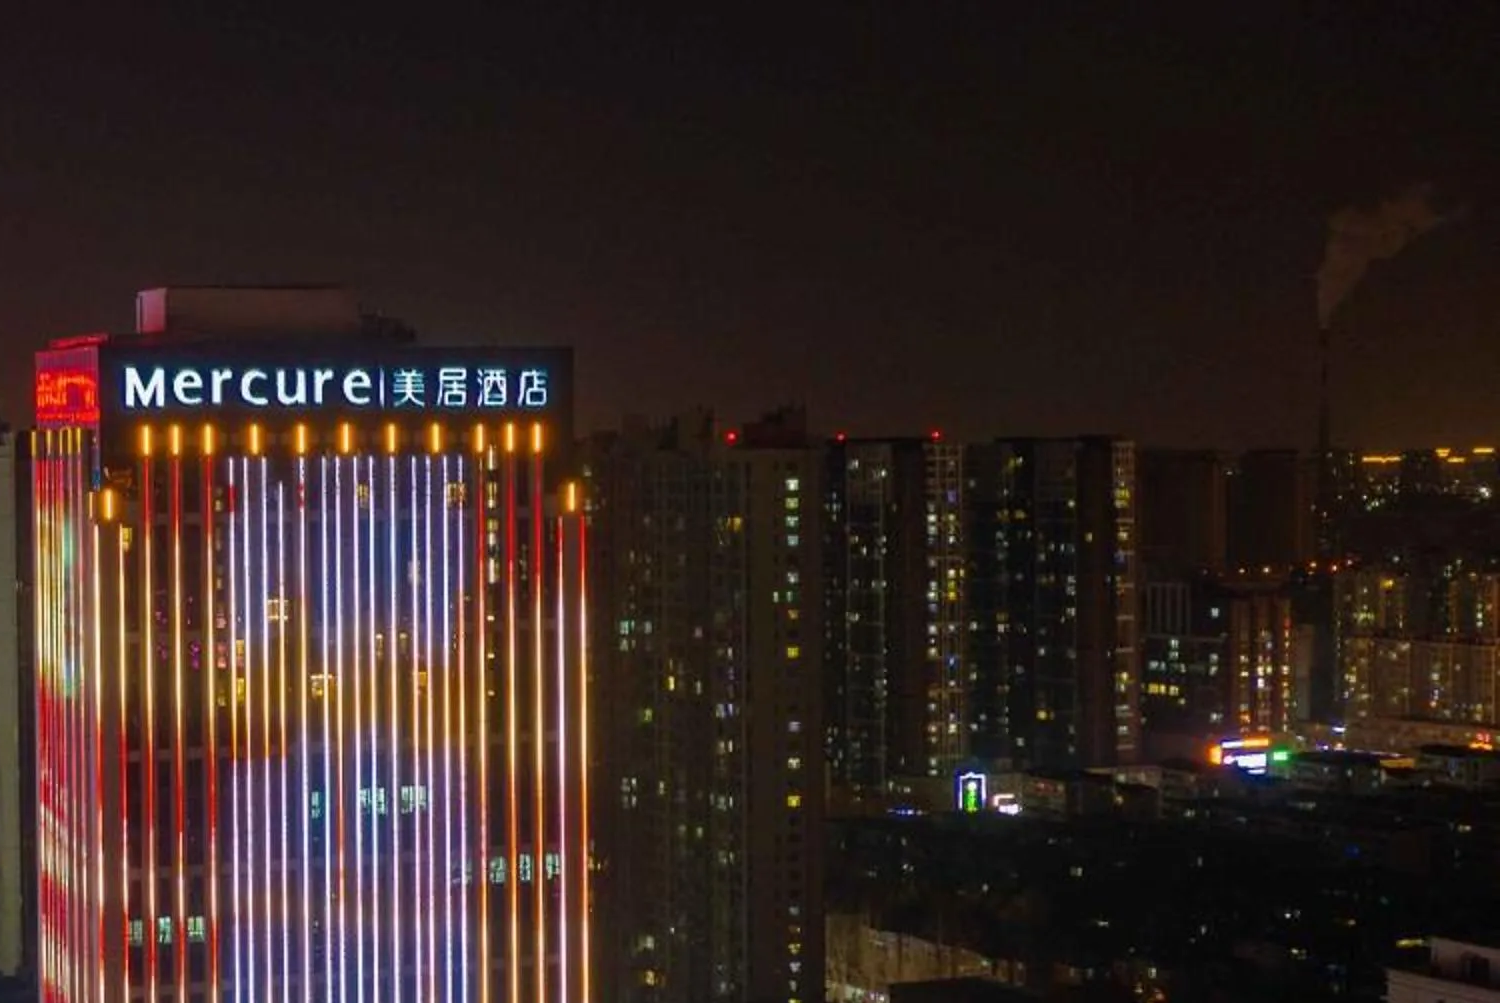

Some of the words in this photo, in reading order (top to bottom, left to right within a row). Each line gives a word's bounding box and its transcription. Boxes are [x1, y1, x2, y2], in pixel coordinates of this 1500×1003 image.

[124, 366, 372, 407] Mercure
[393, 367, 548, 407] 美居酒店
